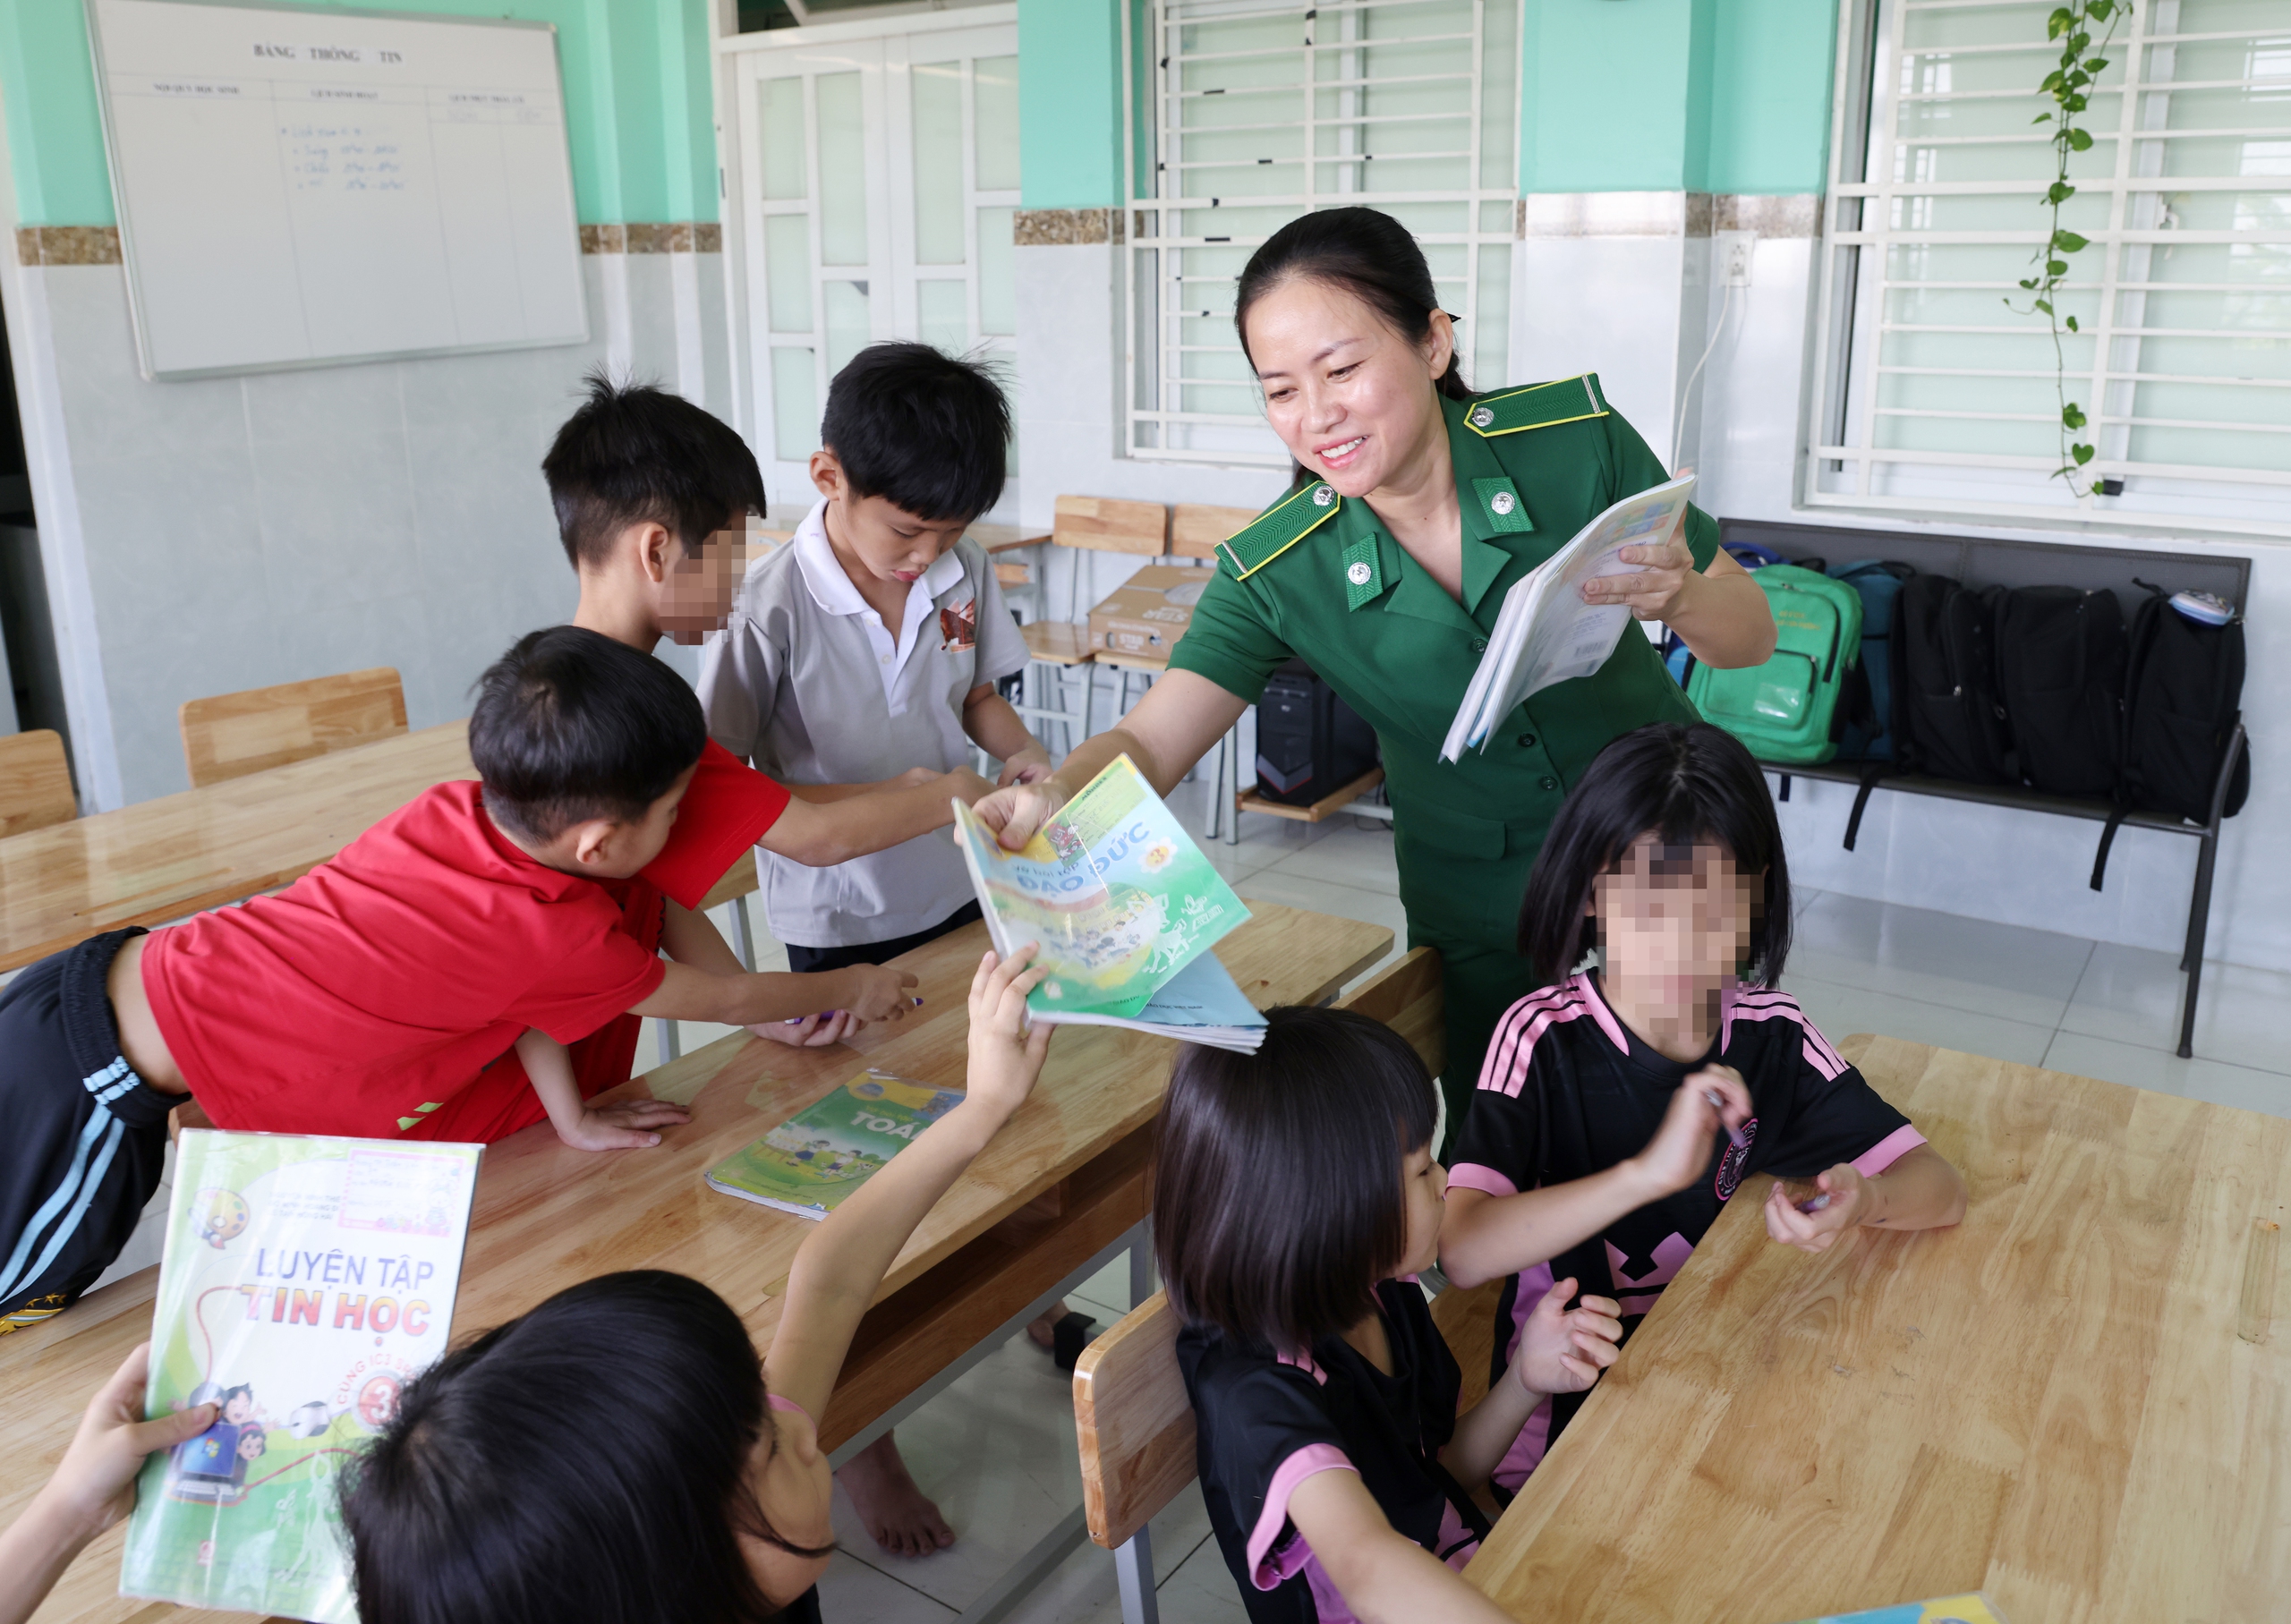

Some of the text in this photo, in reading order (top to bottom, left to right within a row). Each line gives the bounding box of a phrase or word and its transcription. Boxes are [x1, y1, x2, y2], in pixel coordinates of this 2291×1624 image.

[253, 42, 403, 64] BẢNG THÔNG TIN
[1016, 874, 1084, 897] ĐẠO
[1088, 821, 1150, 878] ĐỨC
[256, 1248, 434, 1295] LUYỆN TẬP
[241, 1284, 431, 1347] TIN HỌC
[337, 1360, 366, 1405] CÙNG
[369, 1352, 392, 1366] IC3
[370, 1383, 395, 1420] 3
